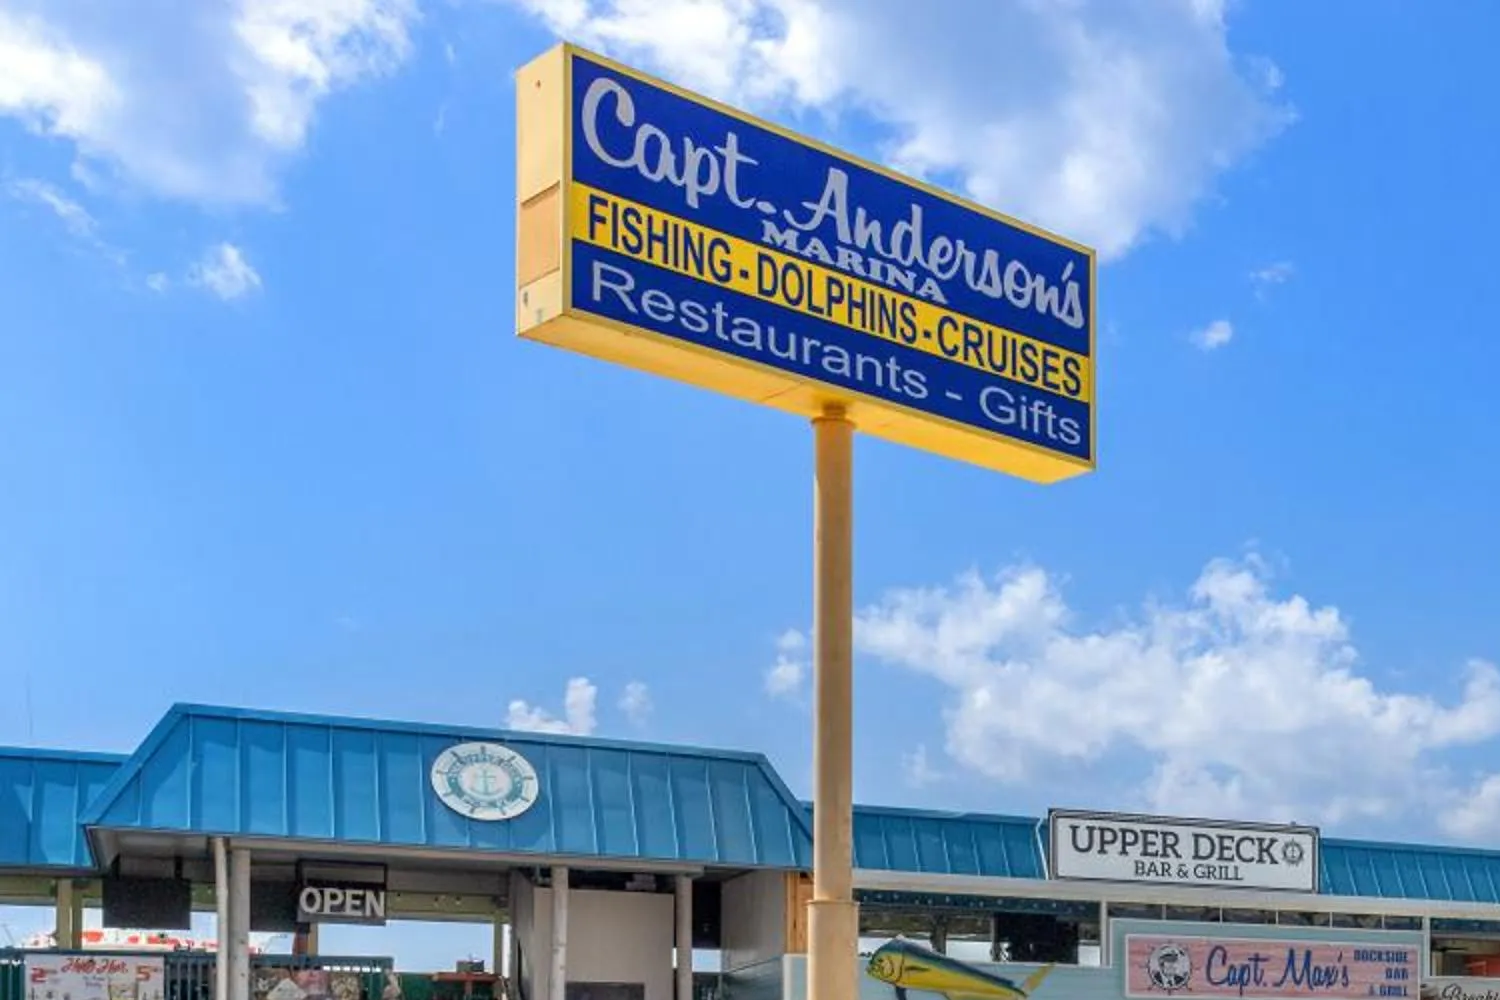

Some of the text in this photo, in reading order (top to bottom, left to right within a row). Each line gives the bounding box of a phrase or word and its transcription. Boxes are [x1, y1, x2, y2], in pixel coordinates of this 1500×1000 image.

[582, 77, 1085, 329] Capt. Anderson's
[761, 219, 946, 305] MARINA
[592, 261, 929, 400] Restaurants
[979, 387, 1081, 446] Gifts
[1069, 825, 1279, 864] UPPER DECK
[1134, 860, 1244, 881] BAR & GRILL
[299, 886, 385, 917] OPEN
[1206, 945, 1267, 995] Capt.
